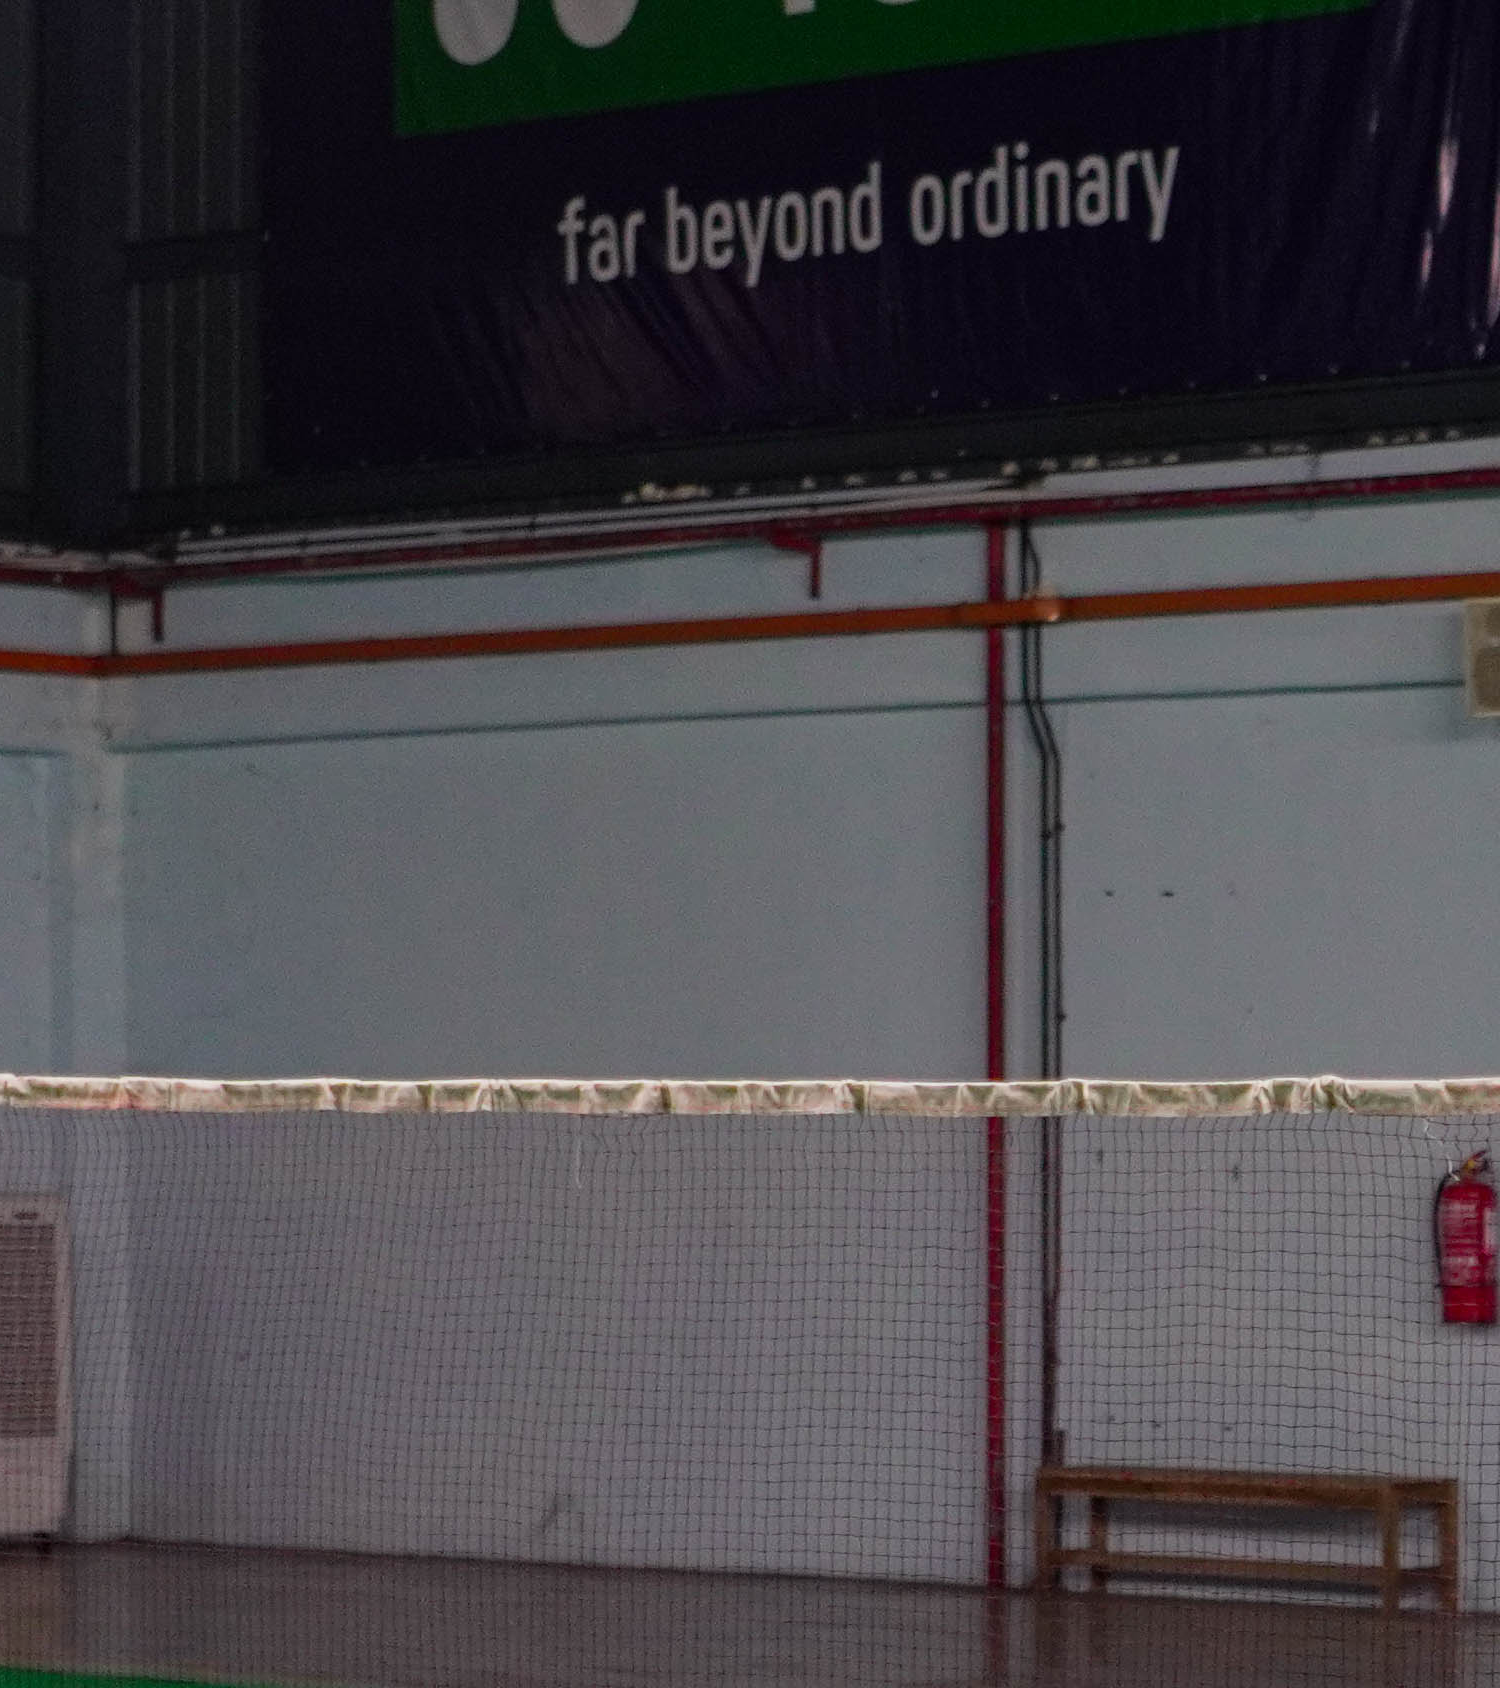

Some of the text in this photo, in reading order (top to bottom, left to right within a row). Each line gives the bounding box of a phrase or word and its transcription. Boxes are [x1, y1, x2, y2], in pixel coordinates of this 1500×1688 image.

[556, 140, 1181, 288] far beyond ordinary
